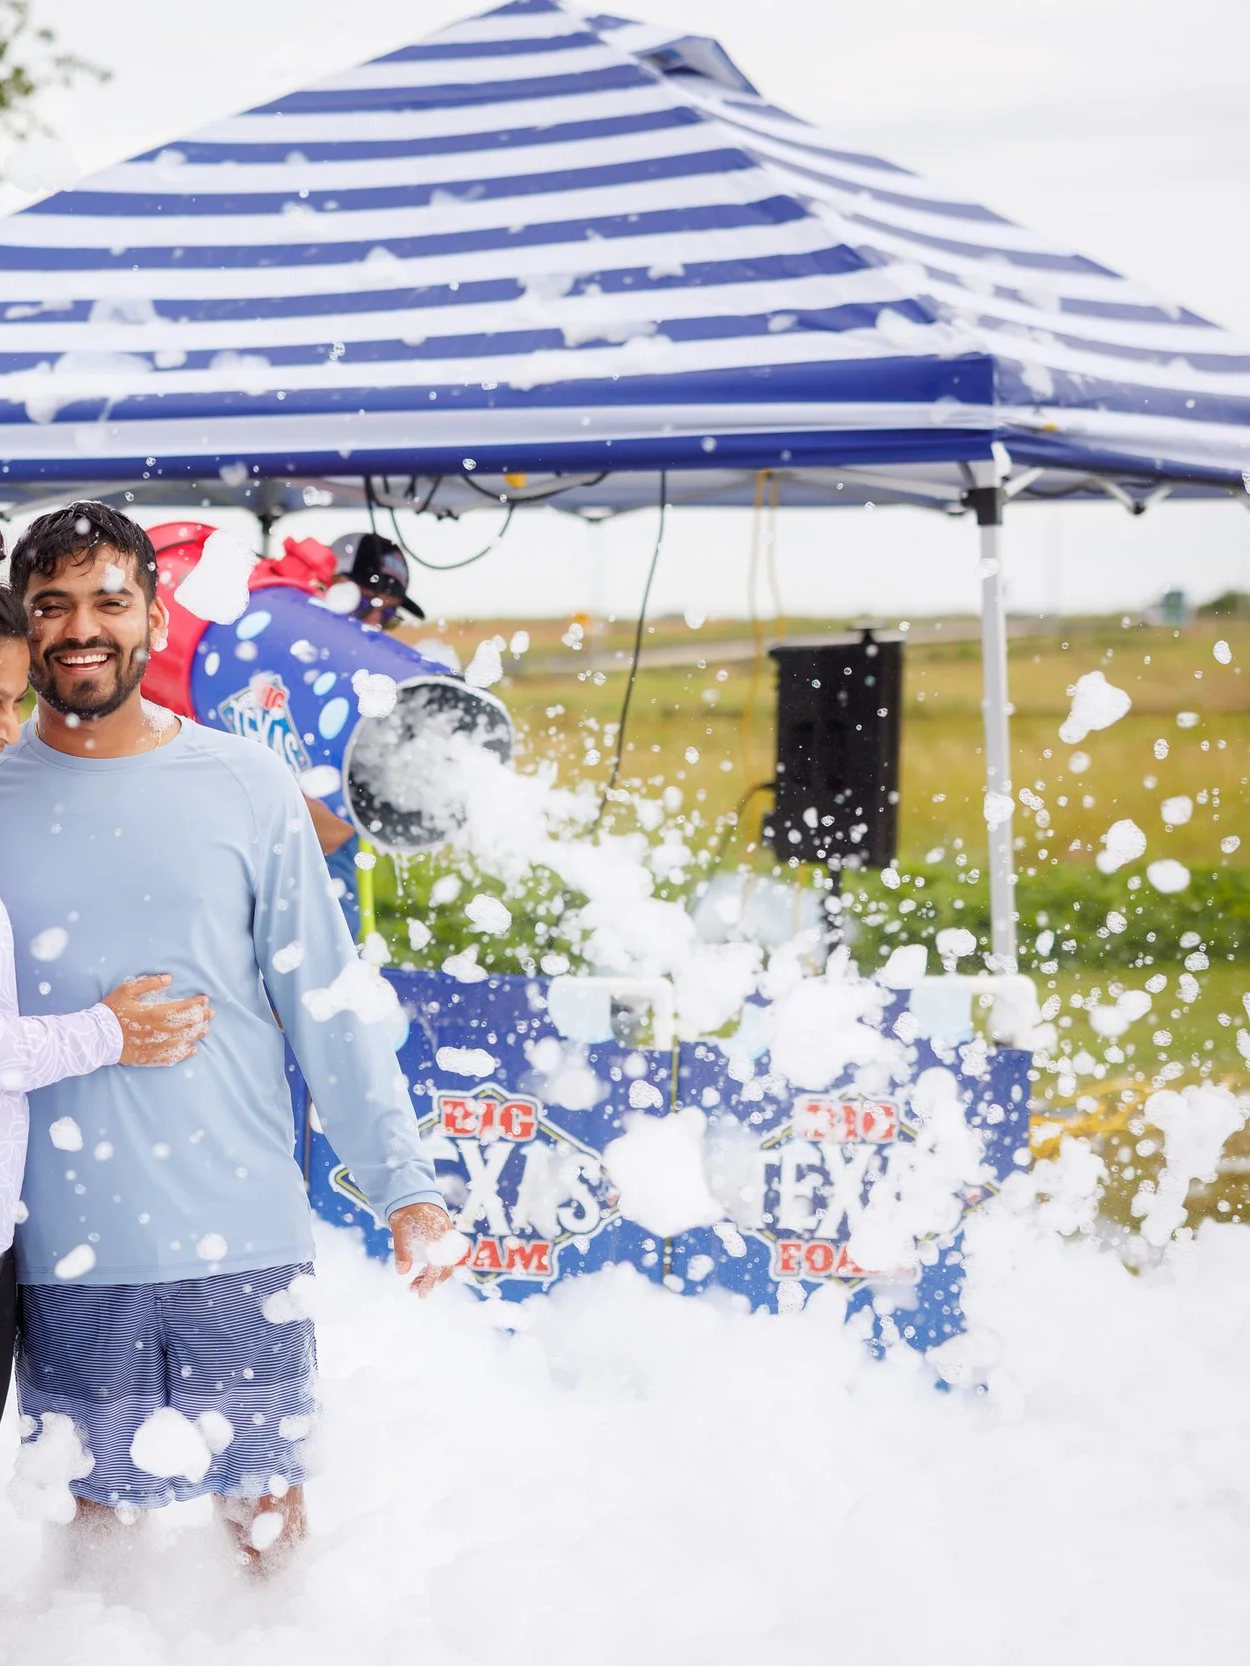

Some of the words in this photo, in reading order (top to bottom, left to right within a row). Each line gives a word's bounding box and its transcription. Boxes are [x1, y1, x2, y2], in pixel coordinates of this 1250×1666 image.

[441, 1099, 535, 1141] BIG
[428, 1137, 600, 1235] XAS
[455, 1239, 550, 1273] AM
